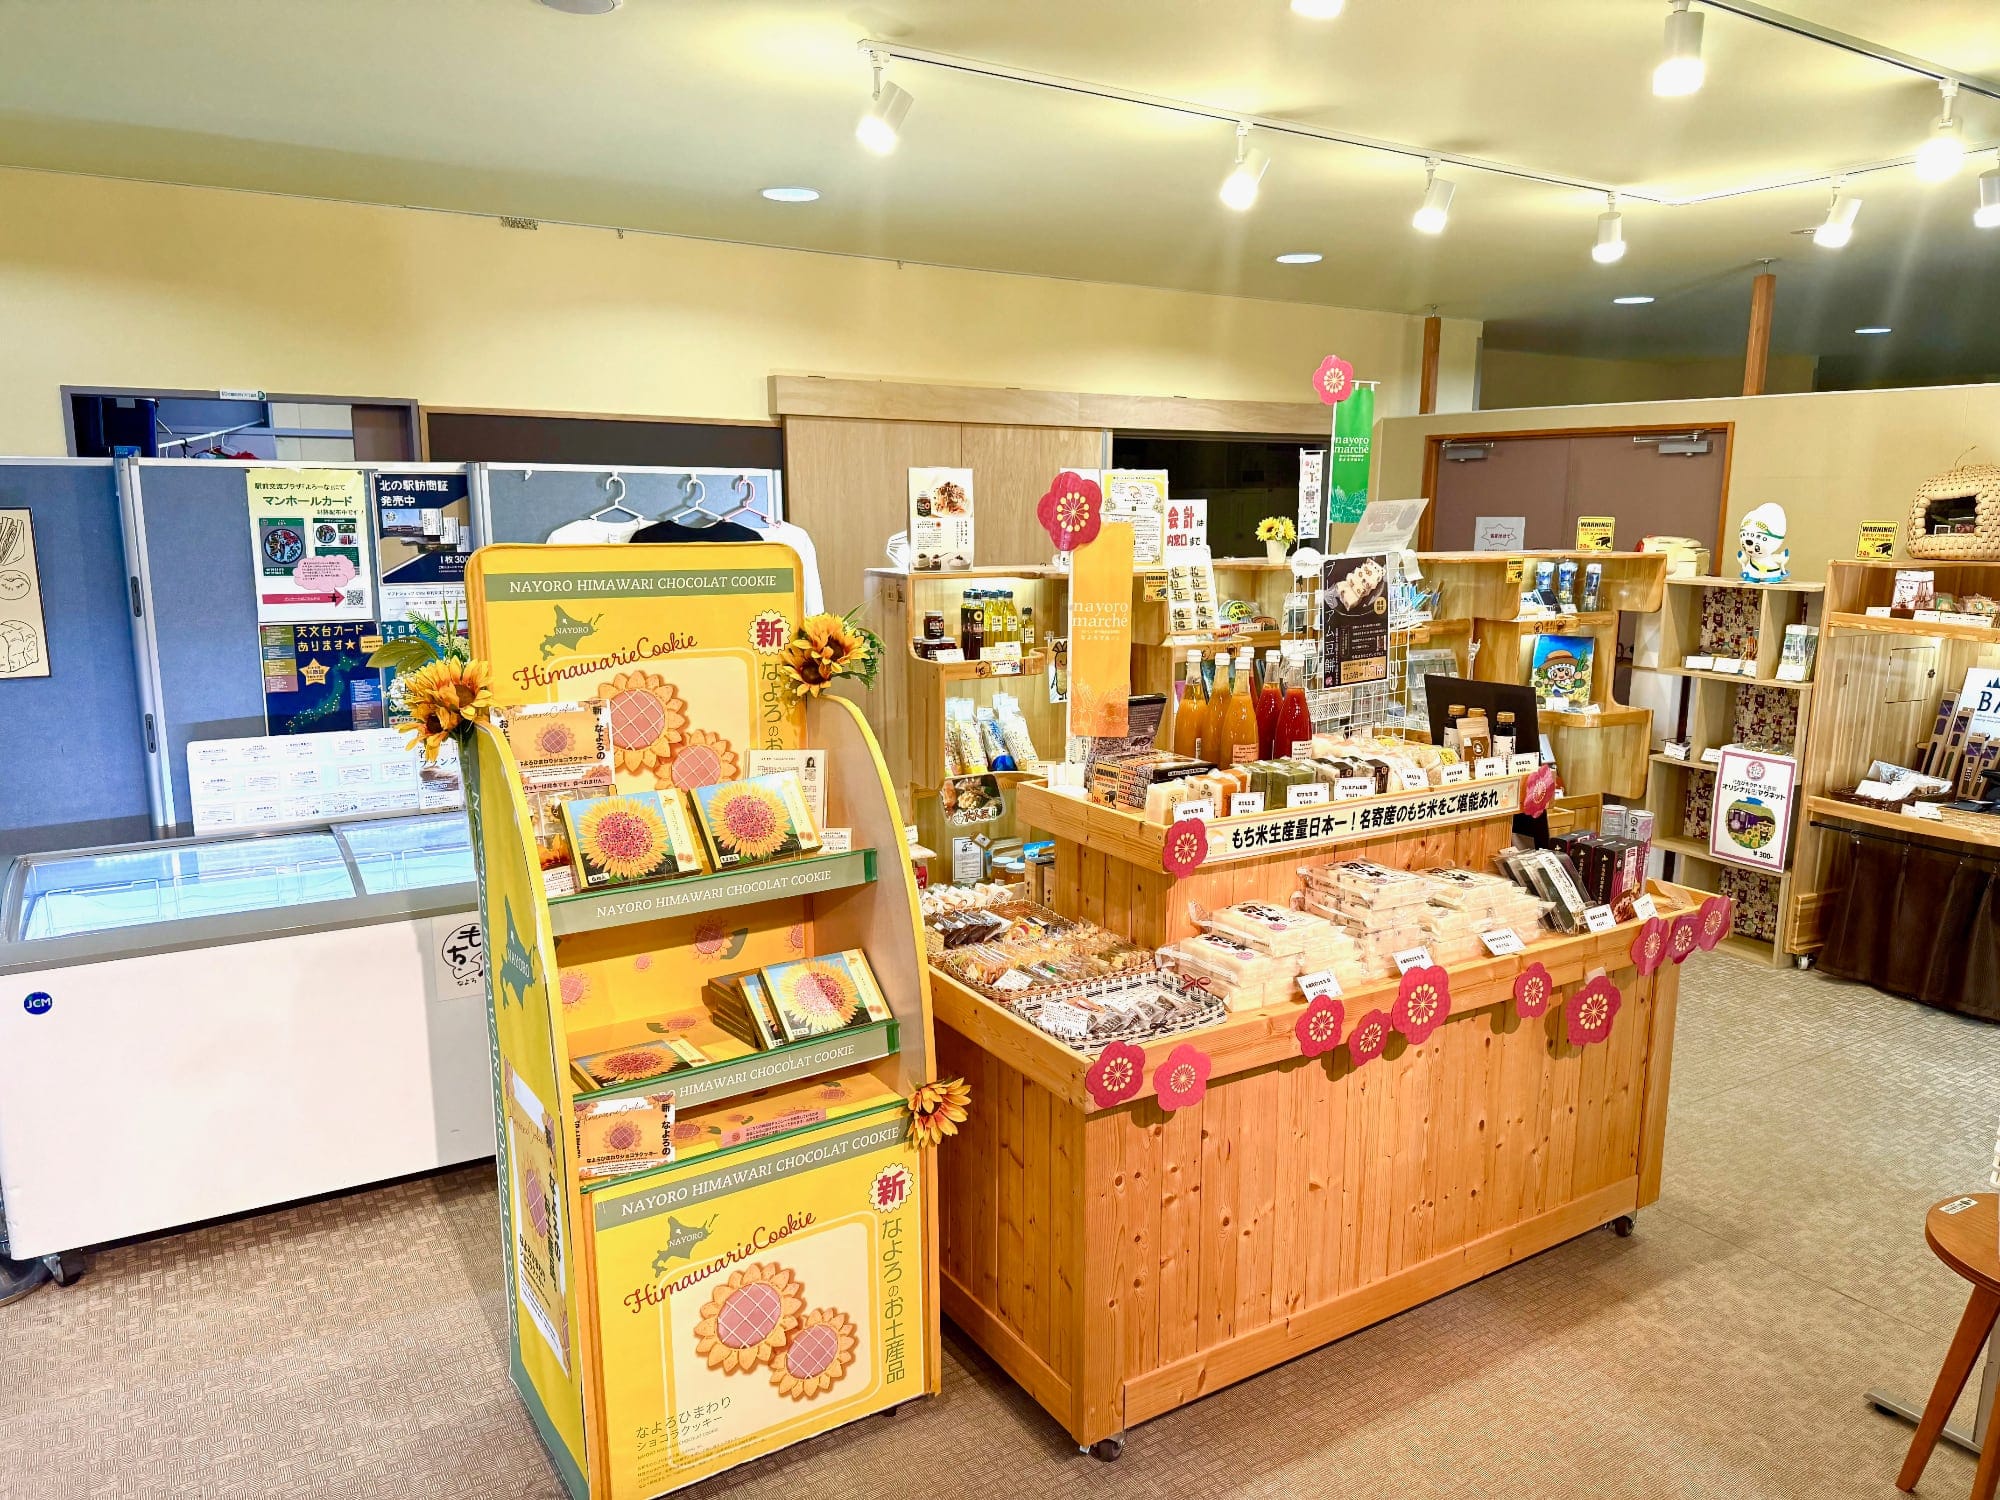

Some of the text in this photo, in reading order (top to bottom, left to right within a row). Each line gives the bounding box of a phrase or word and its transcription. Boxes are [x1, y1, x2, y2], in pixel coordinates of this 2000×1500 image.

[1334, 444, 1369, 454] marché
[1335, 437, 1370, 447] nayoro
[380, 480, 449, 492] 北の駅訪問証
[262, 495, 353, 507] マンホールカード
[381, 495, 416, 507] 発売中
[509, 574, 777, 593] NAYORO HIMAWARI CHOCOLAT COOKIE
[1073, 602, 1129, 617] nayoro
[1071, 613, 1129, 628] marché
[296, 624, 364, 638] 天文台カード
[555, 625, 590, 635] NAYORO
[755, 619, 783, 648] 新
[297, 640, 343, 652] あります
[1232, 787, 1499, 850] もち米生産量日本一！名寄産のもち米をご堪能あれ
[596, 869, 832, 919] NAYORO HIMAWARI CHOCOLAT COOKIE
[507, 948, 530, 980] NAYORO
[25, 997, 52, 1010] JCM
[680, 1044, 856, 1099] HIMAWARI CHOCOLAT COOKIE
[661, 1103, 672, 1156] 新・なよろの
[620, 1187, 689, 1217] NAYORO
[691, 1162, 773, 1198] HIMAWARI
[775, 1140, 849, 1173] CHOCOLAT
[851, 1125, 900, 1152] COOKIE
[876, 1170, 906, 1207] 新
[668, 1230, 704, 1248] NAYORO
[881, 1217, 906, 1385] なよろのお土産品
[636, 1396, 732, 1439] なよろひまわり
[636, 1416, 724, 1452] ショコラクッキー
